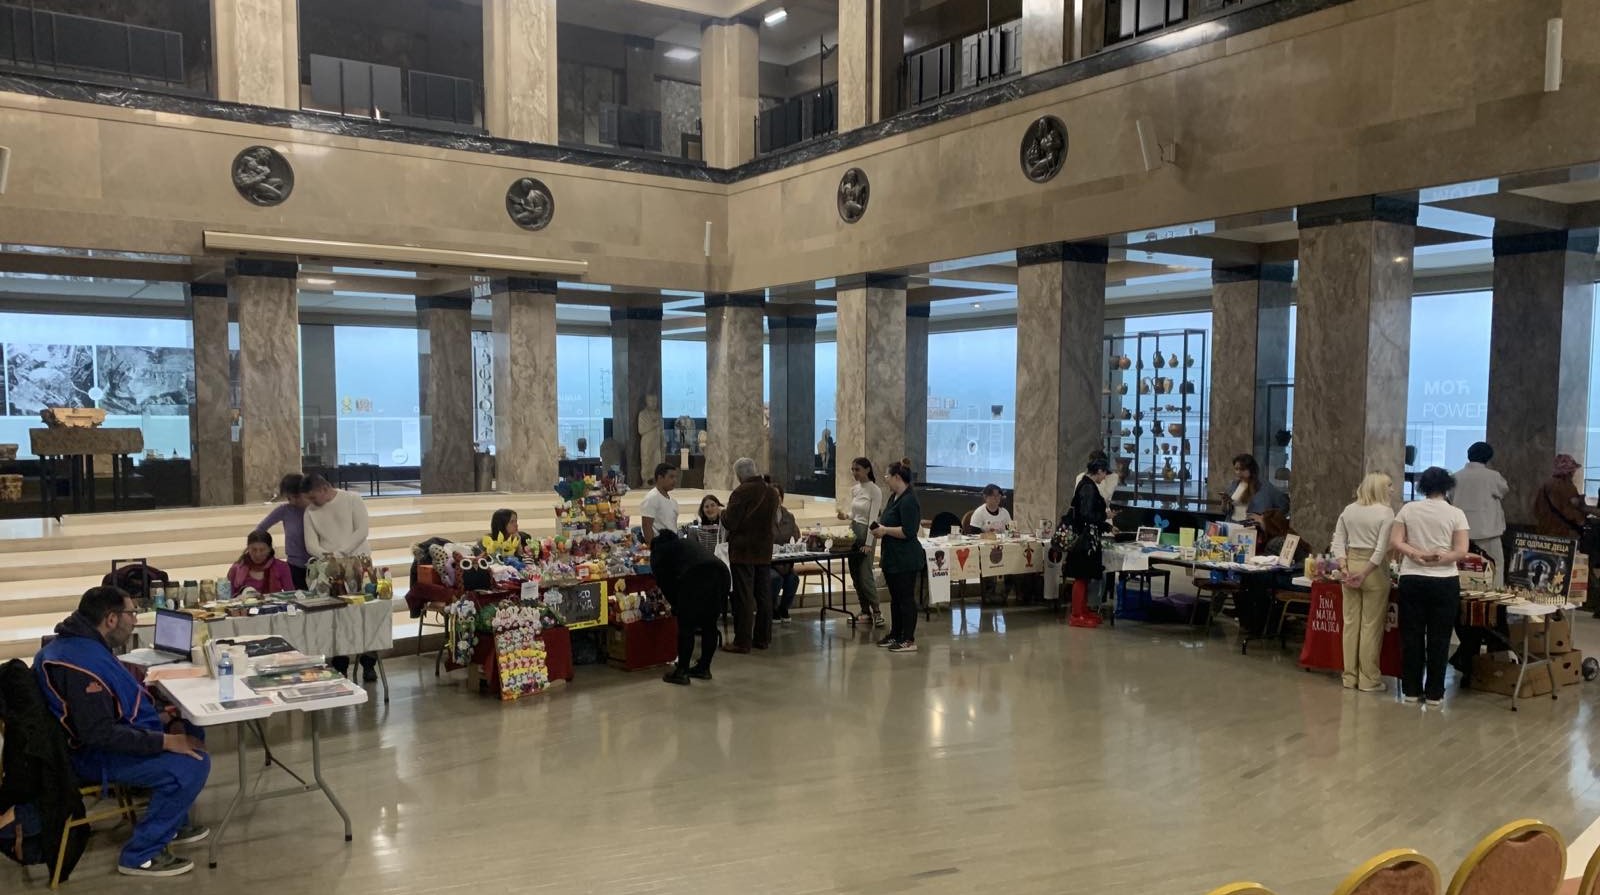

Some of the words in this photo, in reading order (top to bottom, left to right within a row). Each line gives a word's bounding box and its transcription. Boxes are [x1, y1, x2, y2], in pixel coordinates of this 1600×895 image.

[1424, 379, 1471, 395] МОЋ
[1515, 538, 1526, 546] ГДЕ
[1527, 540, 1551, 549] ОДЛАЗЕ
[1551, 543, 1569, 552] ДЕЦА
[1316, 609, 1336, 621] MAJKA
[1312, 620, 1340, 633] KRALJICA
